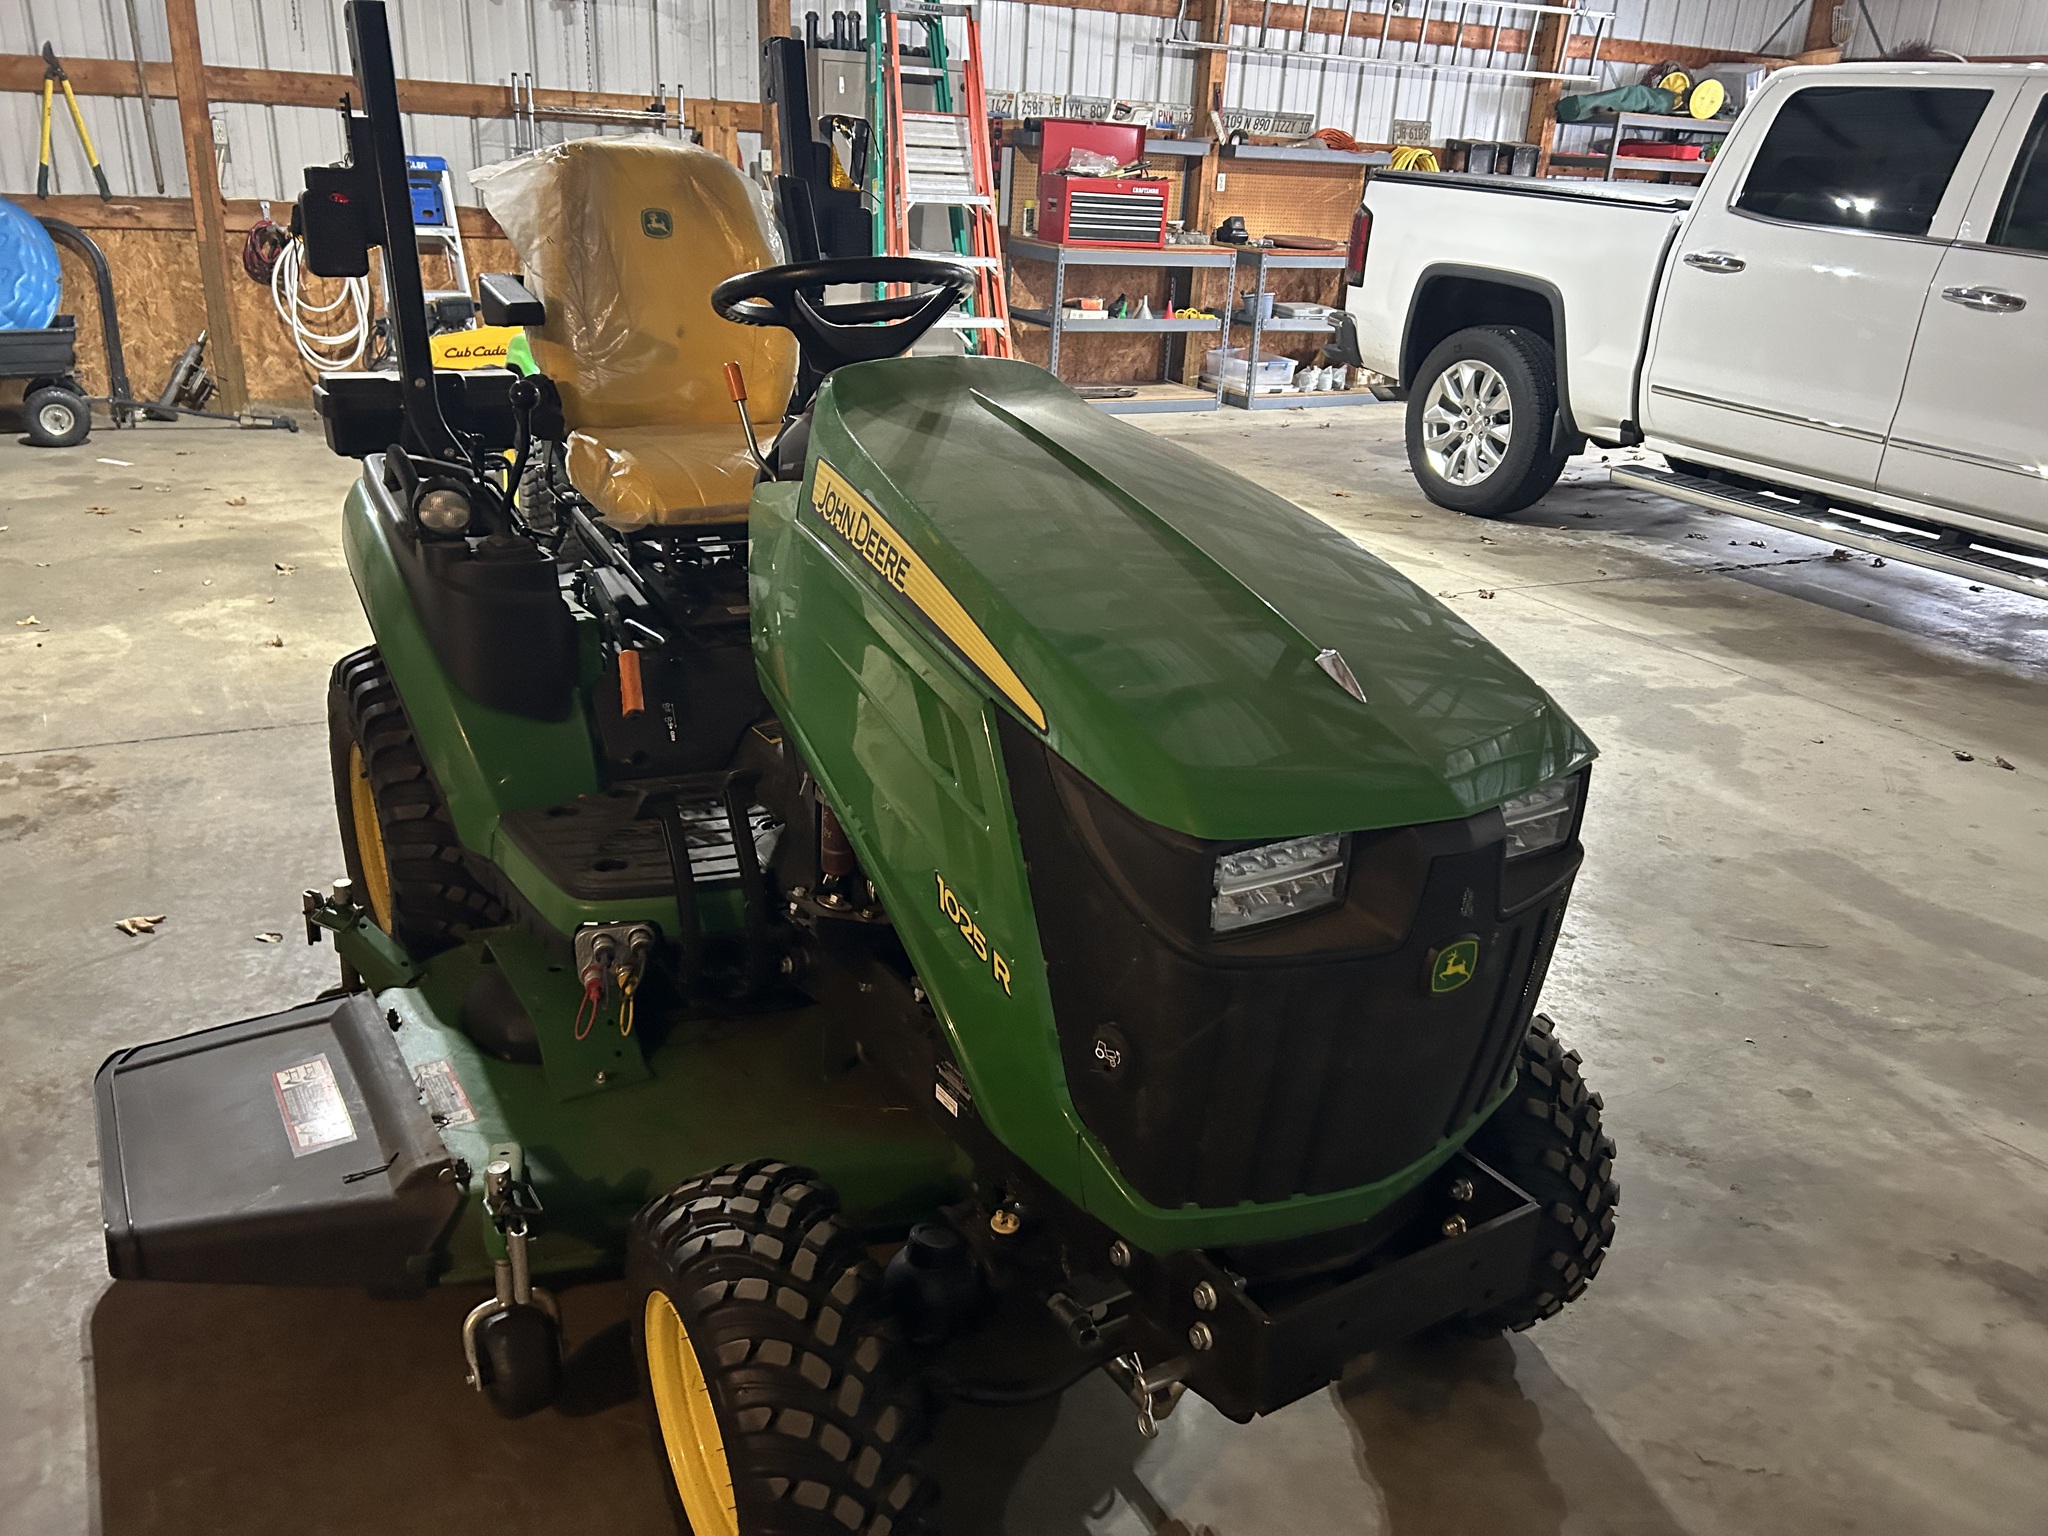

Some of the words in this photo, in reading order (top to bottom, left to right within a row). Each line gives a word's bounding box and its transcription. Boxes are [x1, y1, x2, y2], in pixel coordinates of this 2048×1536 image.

[918, 4, 944, 13] KELLER
[991, 98, 1013, 114] 1427
[1253, 118, 1271, 132] 890
[444, 346, 472, 359] Cub
[472, 345, 507, 357] Cade
[817, 481, 857, 539] JOHN
[853, 510, 911, 591] DEERE
[935, 871, 988, 962] 1025
[992, 948, 1012, 998] R
